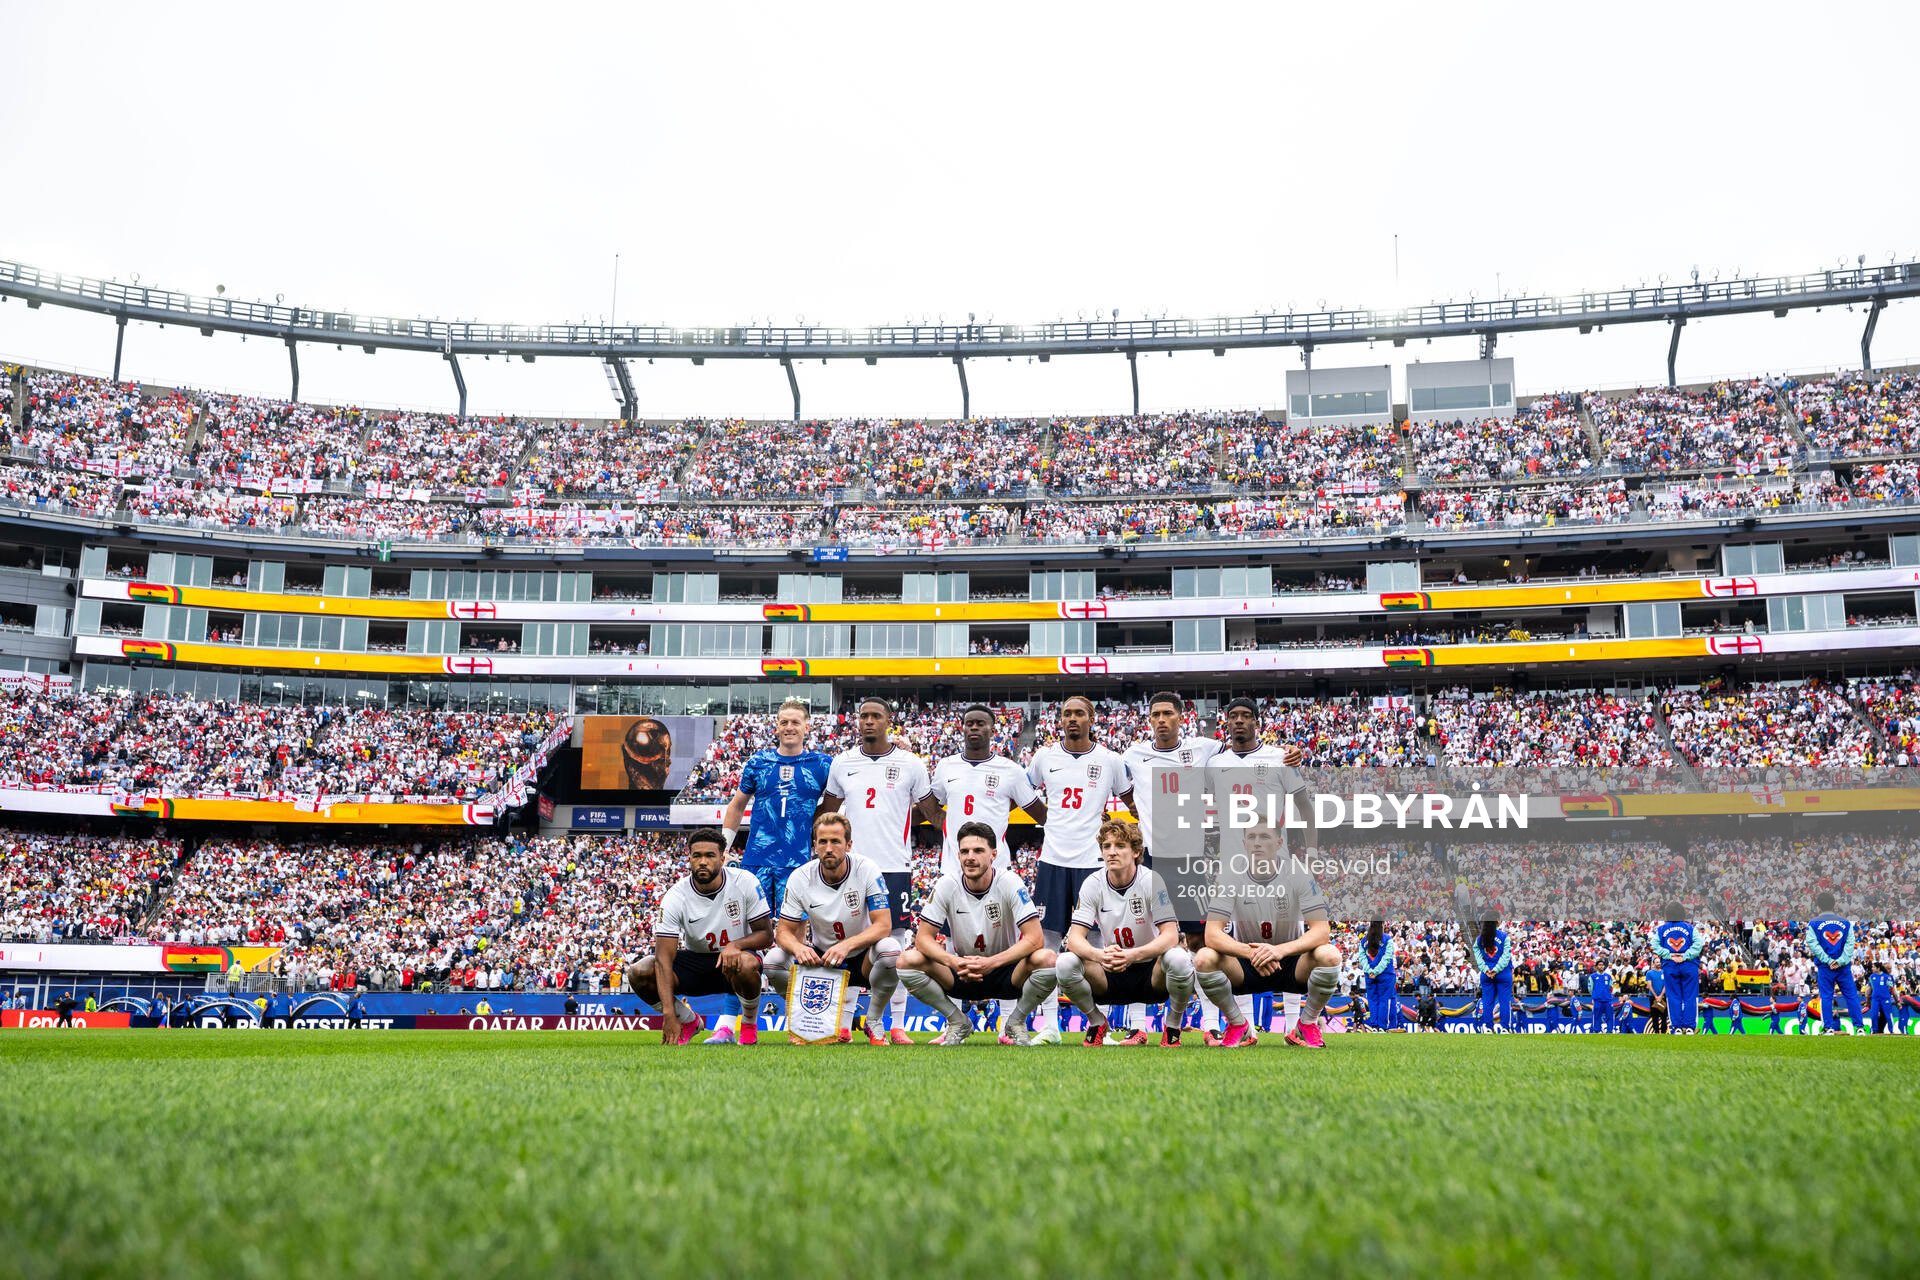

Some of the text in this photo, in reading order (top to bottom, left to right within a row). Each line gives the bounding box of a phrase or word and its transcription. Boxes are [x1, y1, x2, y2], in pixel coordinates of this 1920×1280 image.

[1160, 771, 1180, 794] 10
[780, 796, 787, 818] 1
[865, 787, 876, 809] 2
[964, 794, 975, 816] 6
[1061, 787, 1083, 810] 25
[589, 811, 607, 819] FIFA
[640, 814, 657, 822] FIFA
[900, 891, 910, 913] 2
[832, 921, 846, 941] 9
[1260, 921, 1273, 940] 8
[1662, 928, 1690, 938] VOLUNTEER
[1817, 920, 1846, 931] VOLUNTEER
[705, 929, 730, 952] 24
[973, 933, 986, 953] 4
[1113, 927, 1135, 949] 18
[469, 1016, 544, 1030] QATAR
[555, 1016, 651, 1030] AIRWAYS
